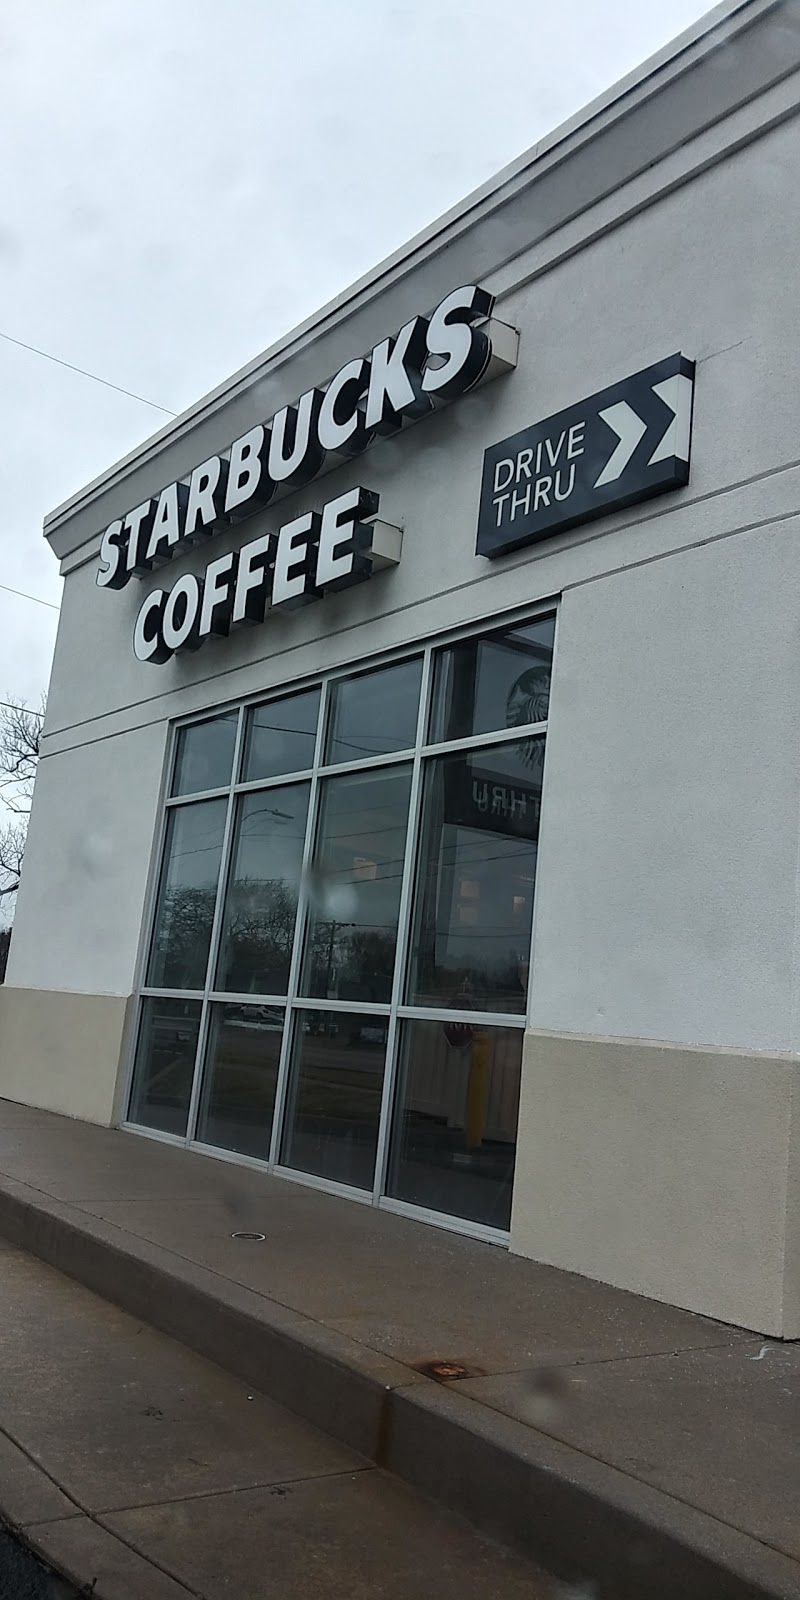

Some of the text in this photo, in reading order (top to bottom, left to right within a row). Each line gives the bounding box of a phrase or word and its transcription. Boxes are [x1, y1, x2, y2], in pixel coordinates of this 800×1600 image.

[97, 284, 479, 588] STARBUCKS
[492, 463, 576, 527] THRU
[493, 420, 586, 493] DRIVE
[134, 487, 361, 662] COFFEE
